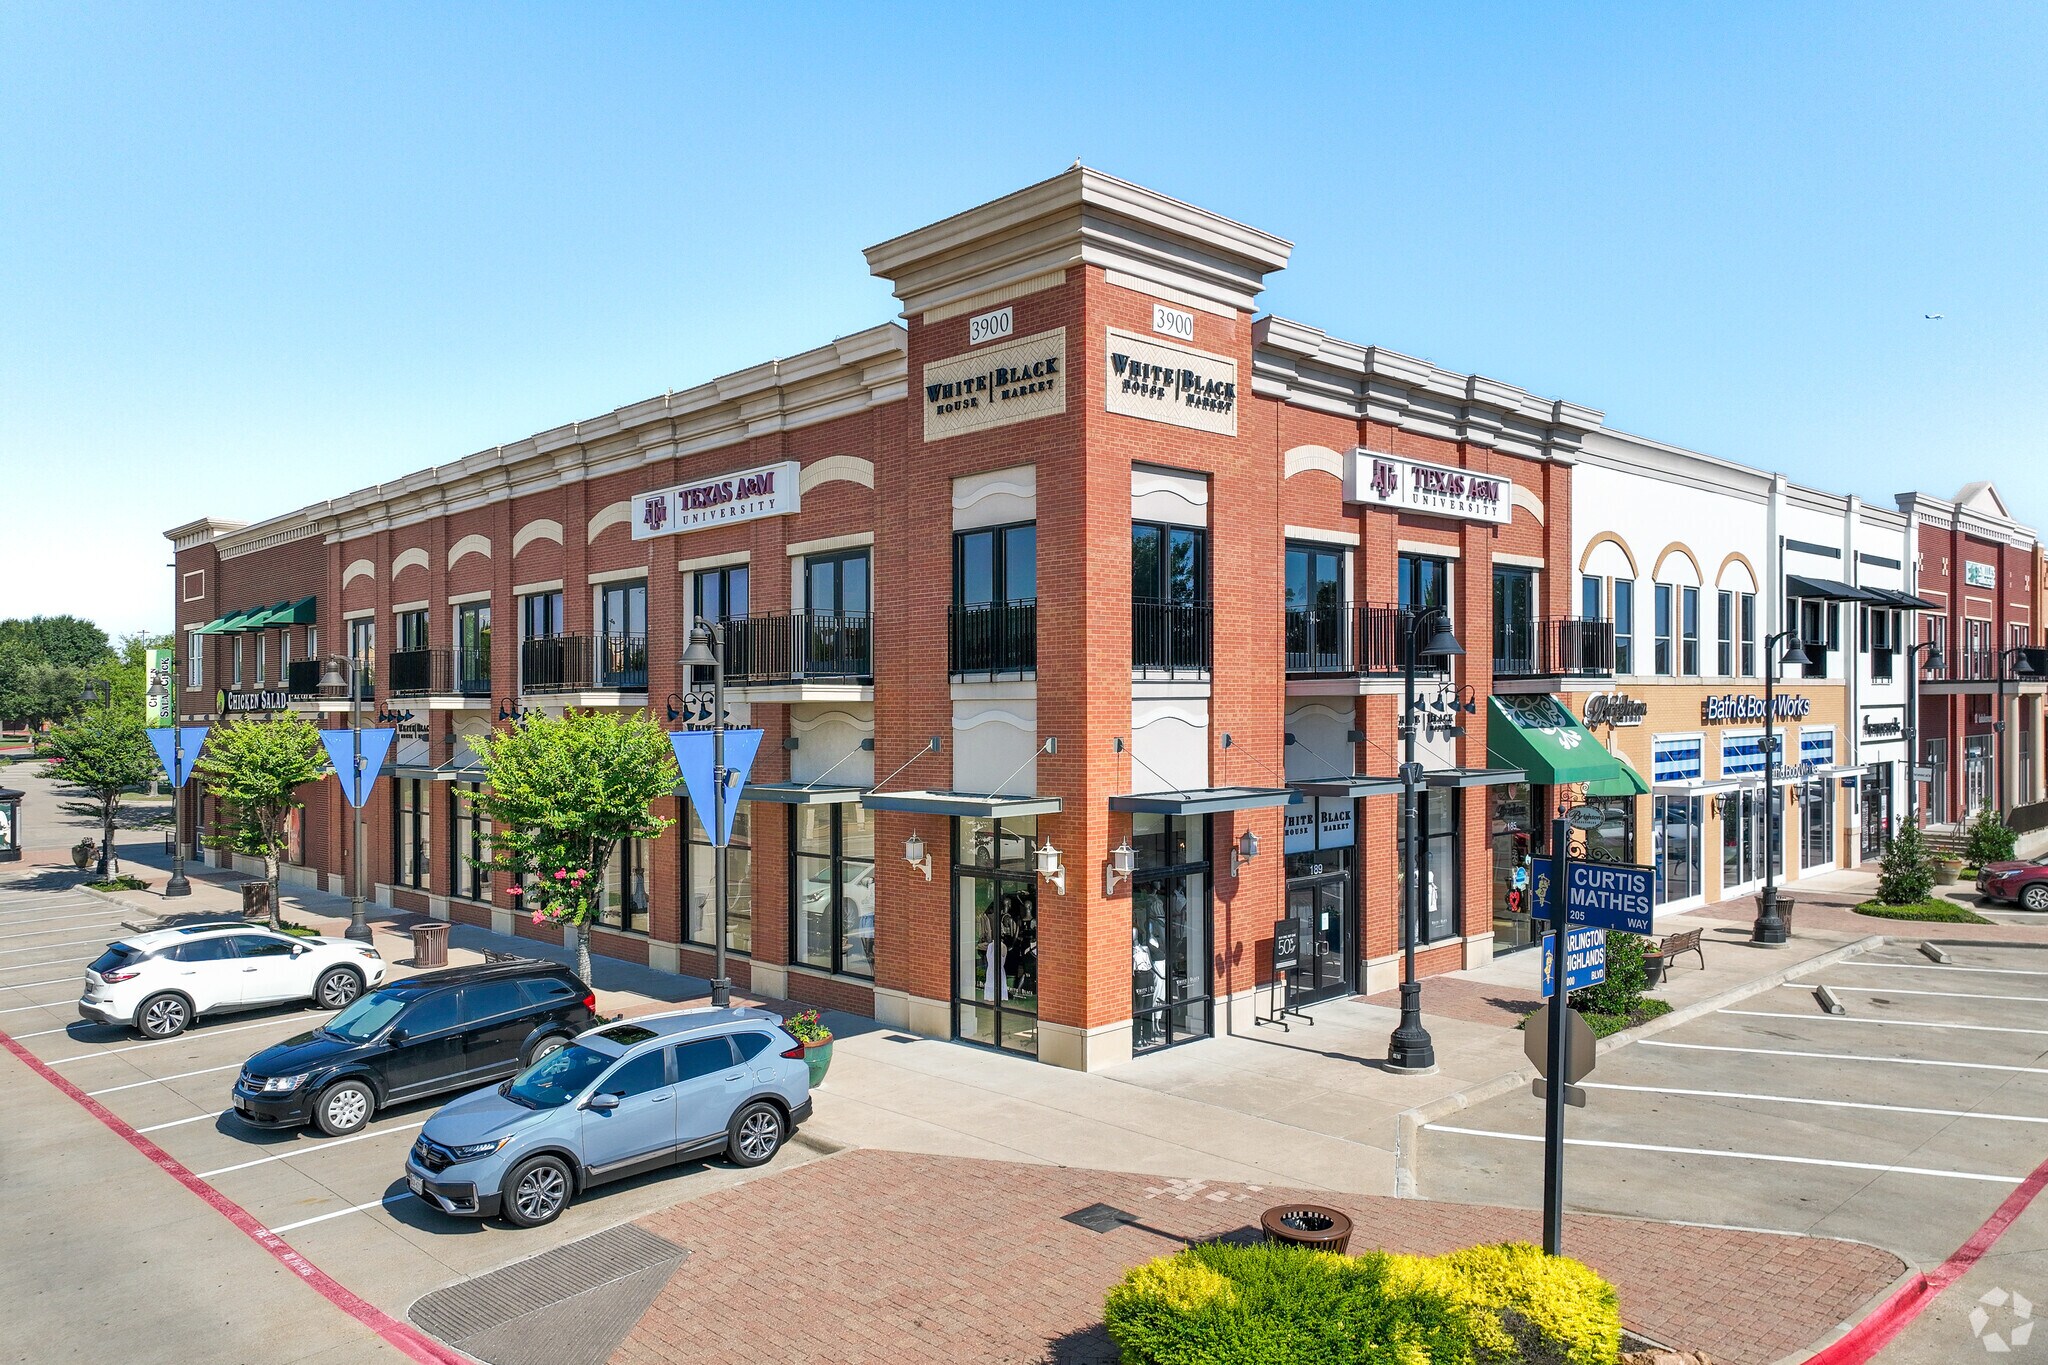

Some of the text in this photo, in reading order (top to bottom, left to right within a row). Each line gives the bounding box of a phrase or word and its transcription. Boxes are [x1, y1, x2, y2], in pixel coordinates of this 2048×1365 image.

[971, 312, 1010, 341] 3900
[1156, 308, 1193, 336] 3900
[926, 357, 1059, 403] WHITE BLACK
[1111, 352, 1236, 399] WHITE BLACK
[936, 379, 1054, 415] HOUSE MARKET
[1122, 379, 1233, 414] HOUSE MARKET
[679, 471, 775, 511] TEXAS A&M
[1411, 466, 1501, 502] TEXAS A&M
[682, 499, 776, 525] UNIVERSITY
[1412, 493, 1498, 517] UNIVERSITY
[228, 691, 260, 711] CHICKEN
[261, 689, 287, 709] SALAD
[1708, 695, 1737, 719] Bath
[1778, 694, 1811, 716] Works
[1321, 810, 1352, 824] BLACK
[1323, 823, 1350, 832] MARKET
[1310, 864, 1323, 875] 189
[1575, 868, 1646, 893] CURTIS
[1570, 887, 1650, 915] MATHES
[1569, 910, 1585, 921] 205
[1627, 918, 1649, 930] WAY
[1591, 969, 1604, 980] BLVD
